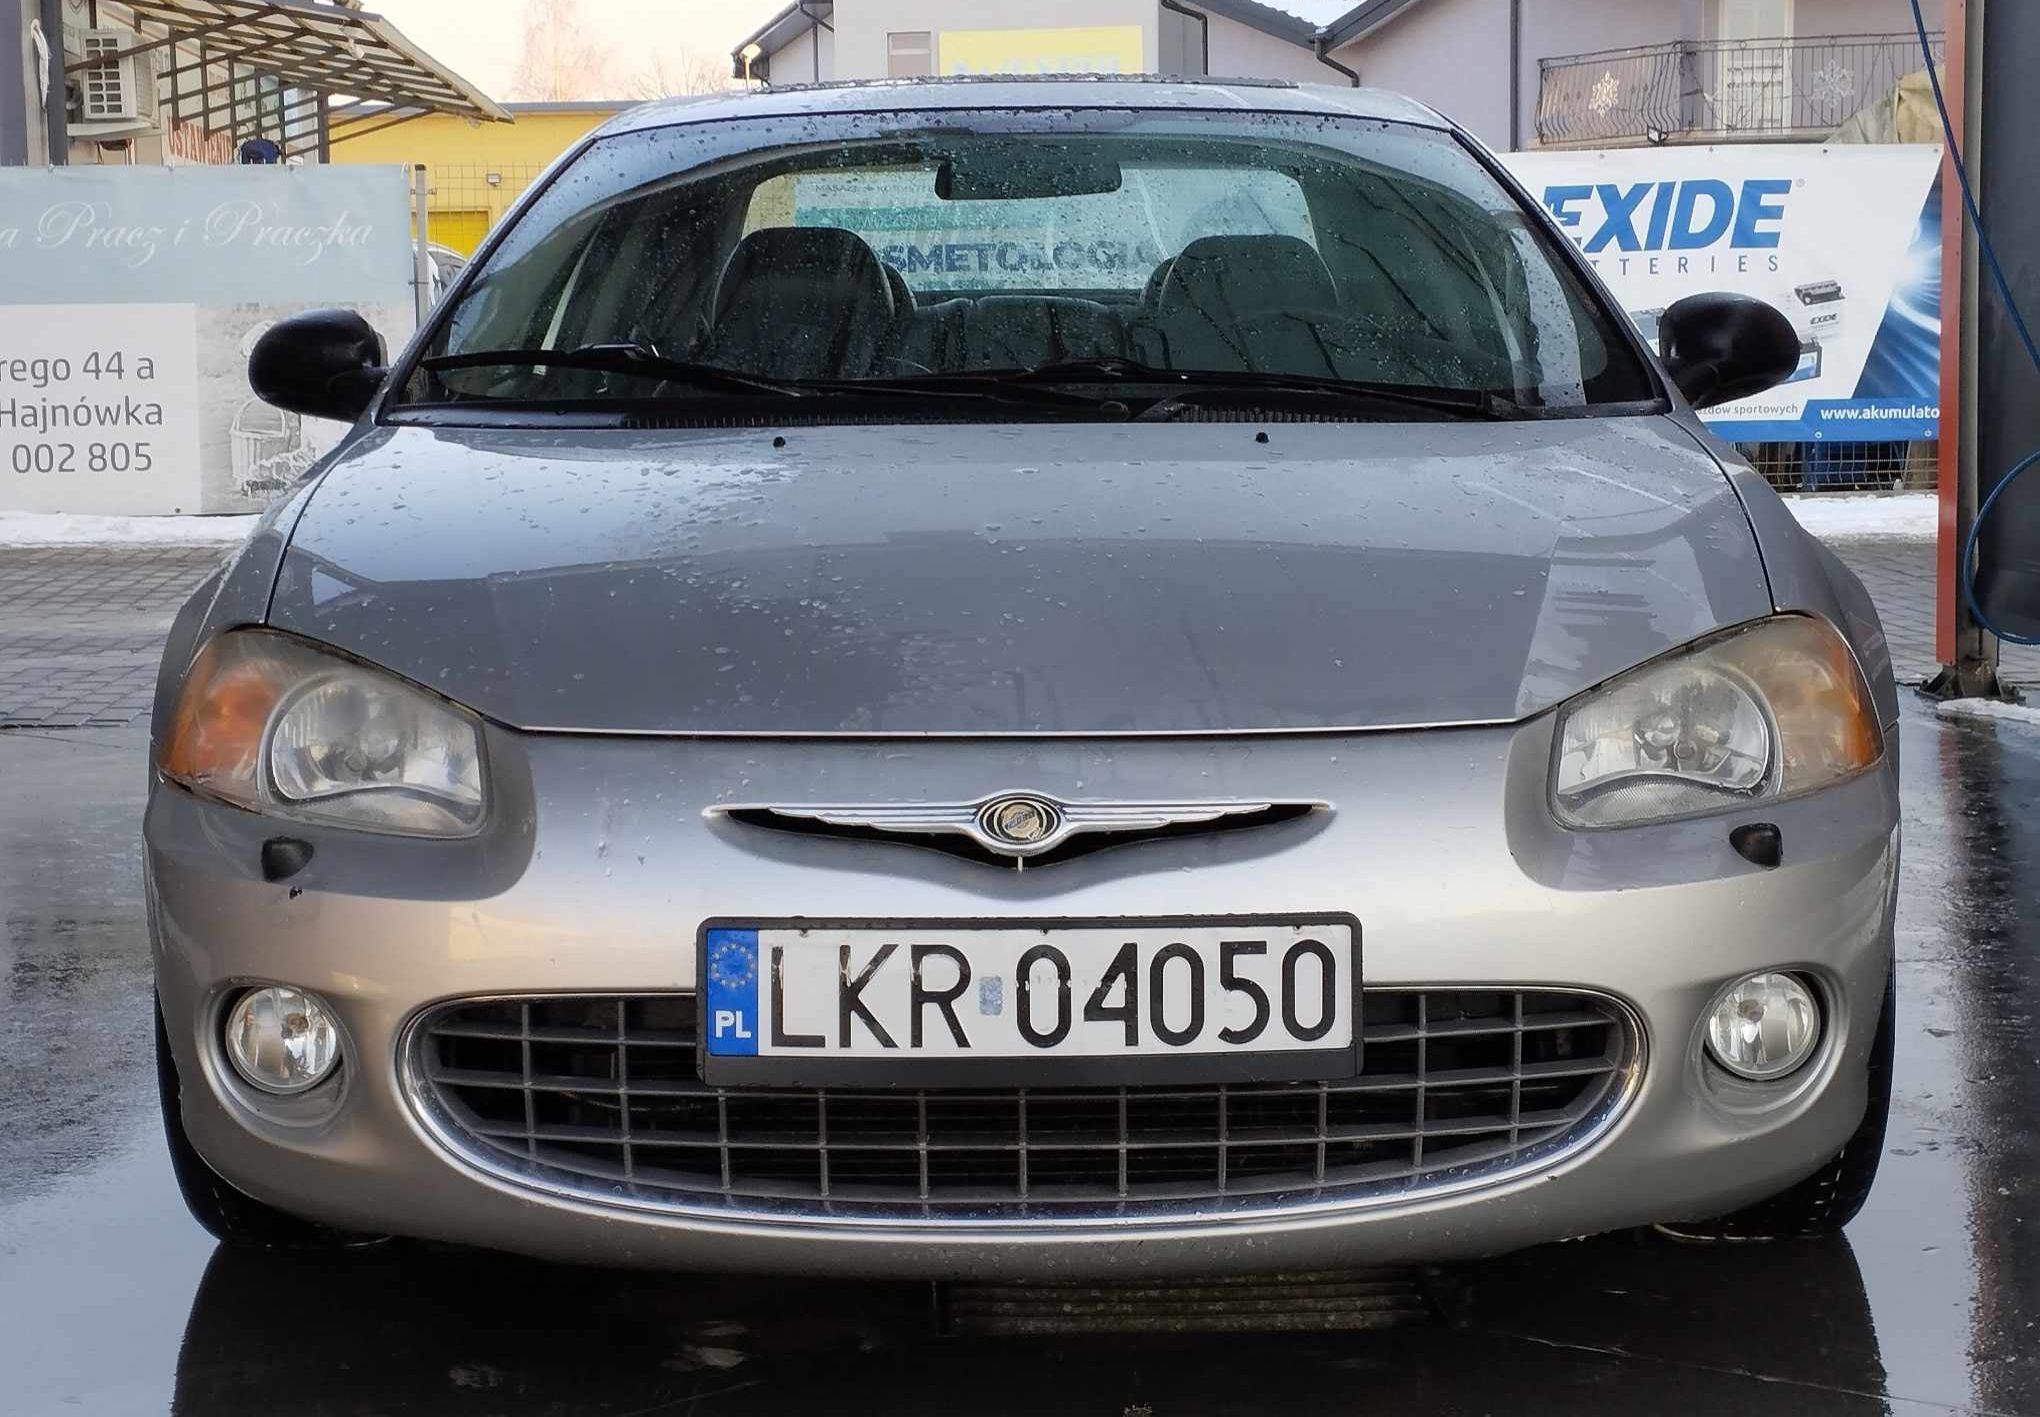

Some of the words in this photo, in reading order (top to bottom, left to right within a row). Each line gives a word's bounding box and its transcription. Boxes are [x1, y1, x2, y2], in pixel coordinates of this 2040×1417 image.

[1543, 179, 1793, 254] EXIDE
[36, 201, 167, 269] Pracz
[173, 219, 190, 247] i
[203, 200, 374, 267] Praczka
[82, 351, 125, 381] 44
[136, 357, 155, 380] a
[0, 395, 163, 434] Hajnówka
[1735, 403, 1798, 417] sportowych
[1820, 405, 1940, 420] www.akumulato
[12, 443, 76, 473] 002
[88, 442, 153, 472] 805
[770, 943, 972, 1049] LKR
[1016, 938, 1336, 1049] 04050
[714, 1009, 752, 1039] PL
